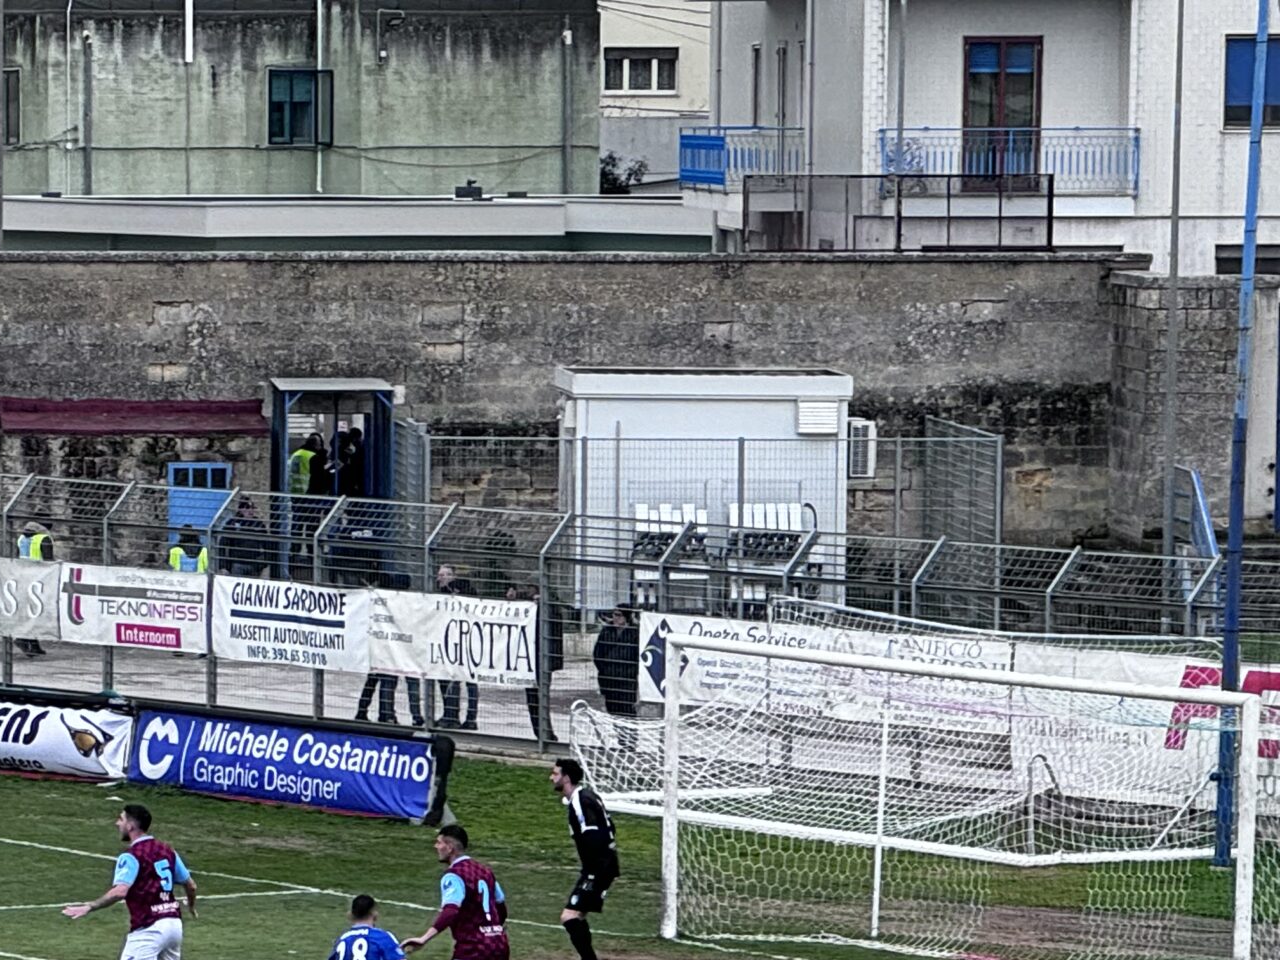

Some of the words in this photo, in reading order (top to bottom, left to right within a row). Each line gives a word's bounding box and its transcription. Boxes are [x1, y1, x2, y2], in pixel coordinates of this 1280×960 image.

[98, 599, 203, 622] TEKNOINFISSI
[231, 581, 281, 609] GIANNI
[282, 586, 347, 616] SARDONE
[120, 625, 177, 646] Internorm
[230, 623, 272, 642] MASSETTI
[273, 627, 345, 651] AUTOLIVELLANTI
[430, 642, 445, 665] LA
[444, 618, 534, 679] GROTTA
[247, 645, 271, 660] INFO:
[272, 647, 289, 661] 392
[197, 720, 286, 763] Michele
[292, 732, 430, 782] Costantino
[193, 756, 259, 789] Graphic
[264, 765, 341, 801] Designer
[154, 859, 173, 892] 5
